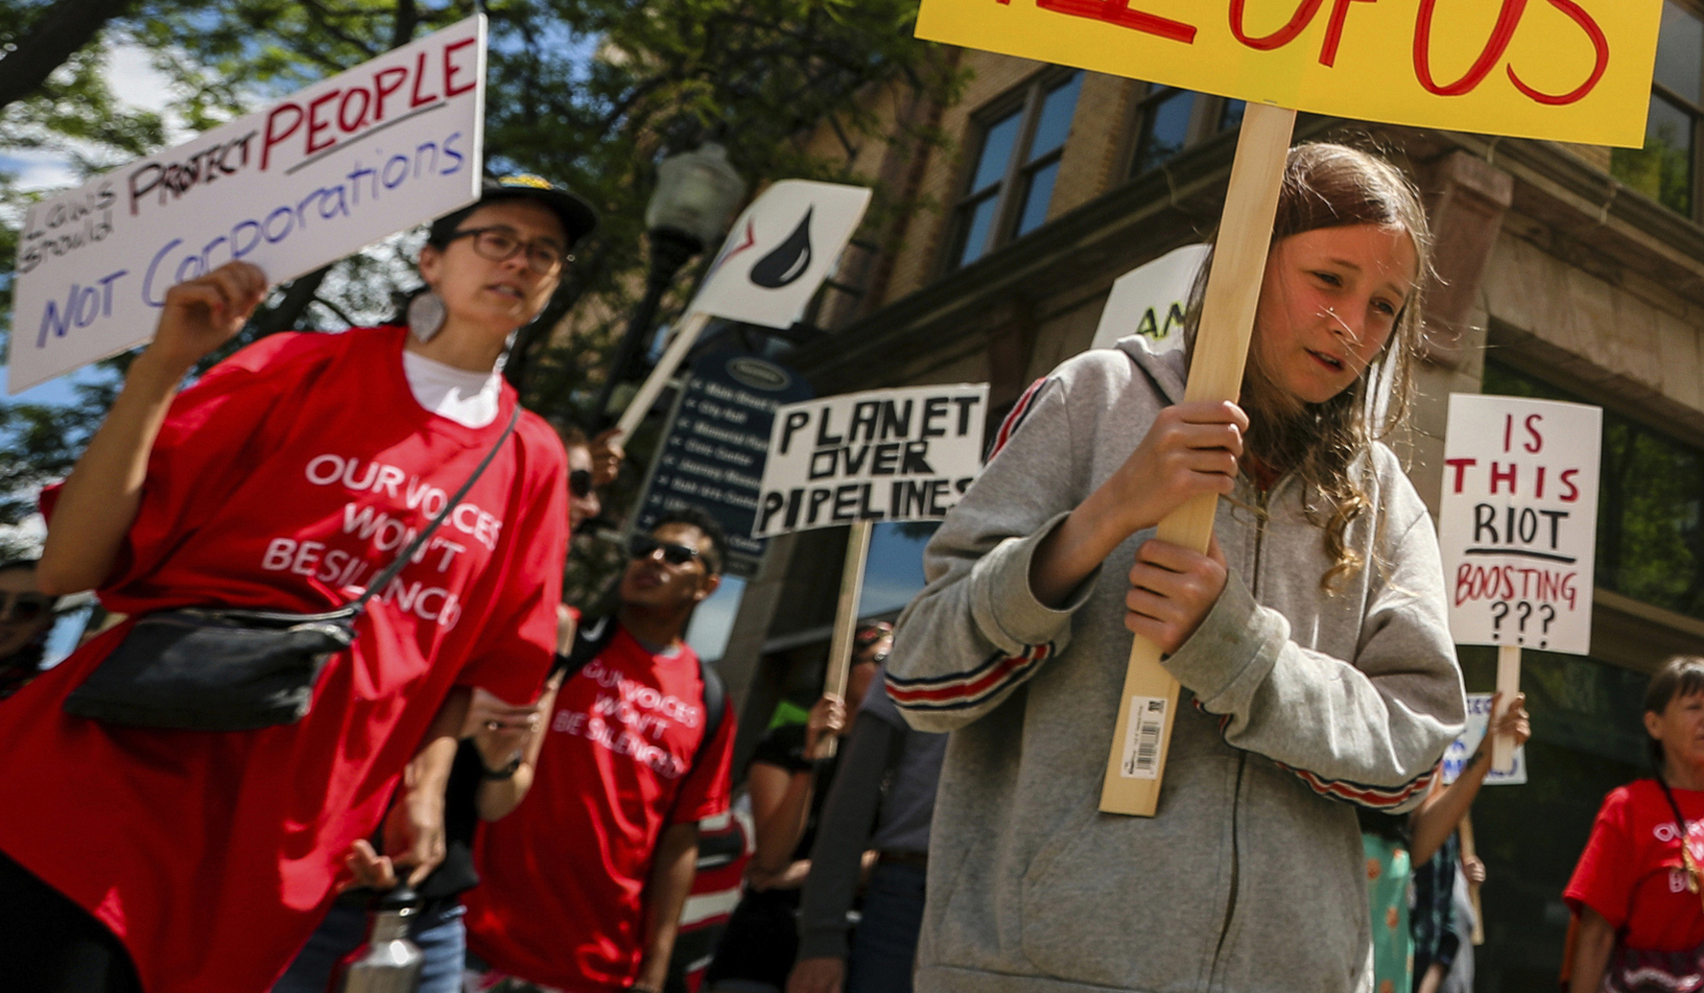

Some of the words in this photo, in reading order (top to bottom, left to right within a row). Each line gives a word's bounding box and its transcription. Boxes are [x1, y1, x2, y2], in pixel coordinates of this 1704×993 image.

[259, 37, 477, 171] PEOPLE
[35, 269, 128, 349] NOT
[141, 131, 465, 307] Corporations
[779, 396, 981, 455] PLANET
[1503, 414, 1543, 453] IS
[305, 453, 406, 499] OUR
[808, 441, 934, 480] OVER
[1444, 458, 1580, 502] THIS
[343, 501, 467, 573] WON'T
[1473, 503, 1570, 549] RIOT
[261, 537, 326, 576] BE
[1455, 563, 1578, 612] BOOSTING
[1491, 601, 1555, 648] ???
[552, 709, 588, 736] BE
